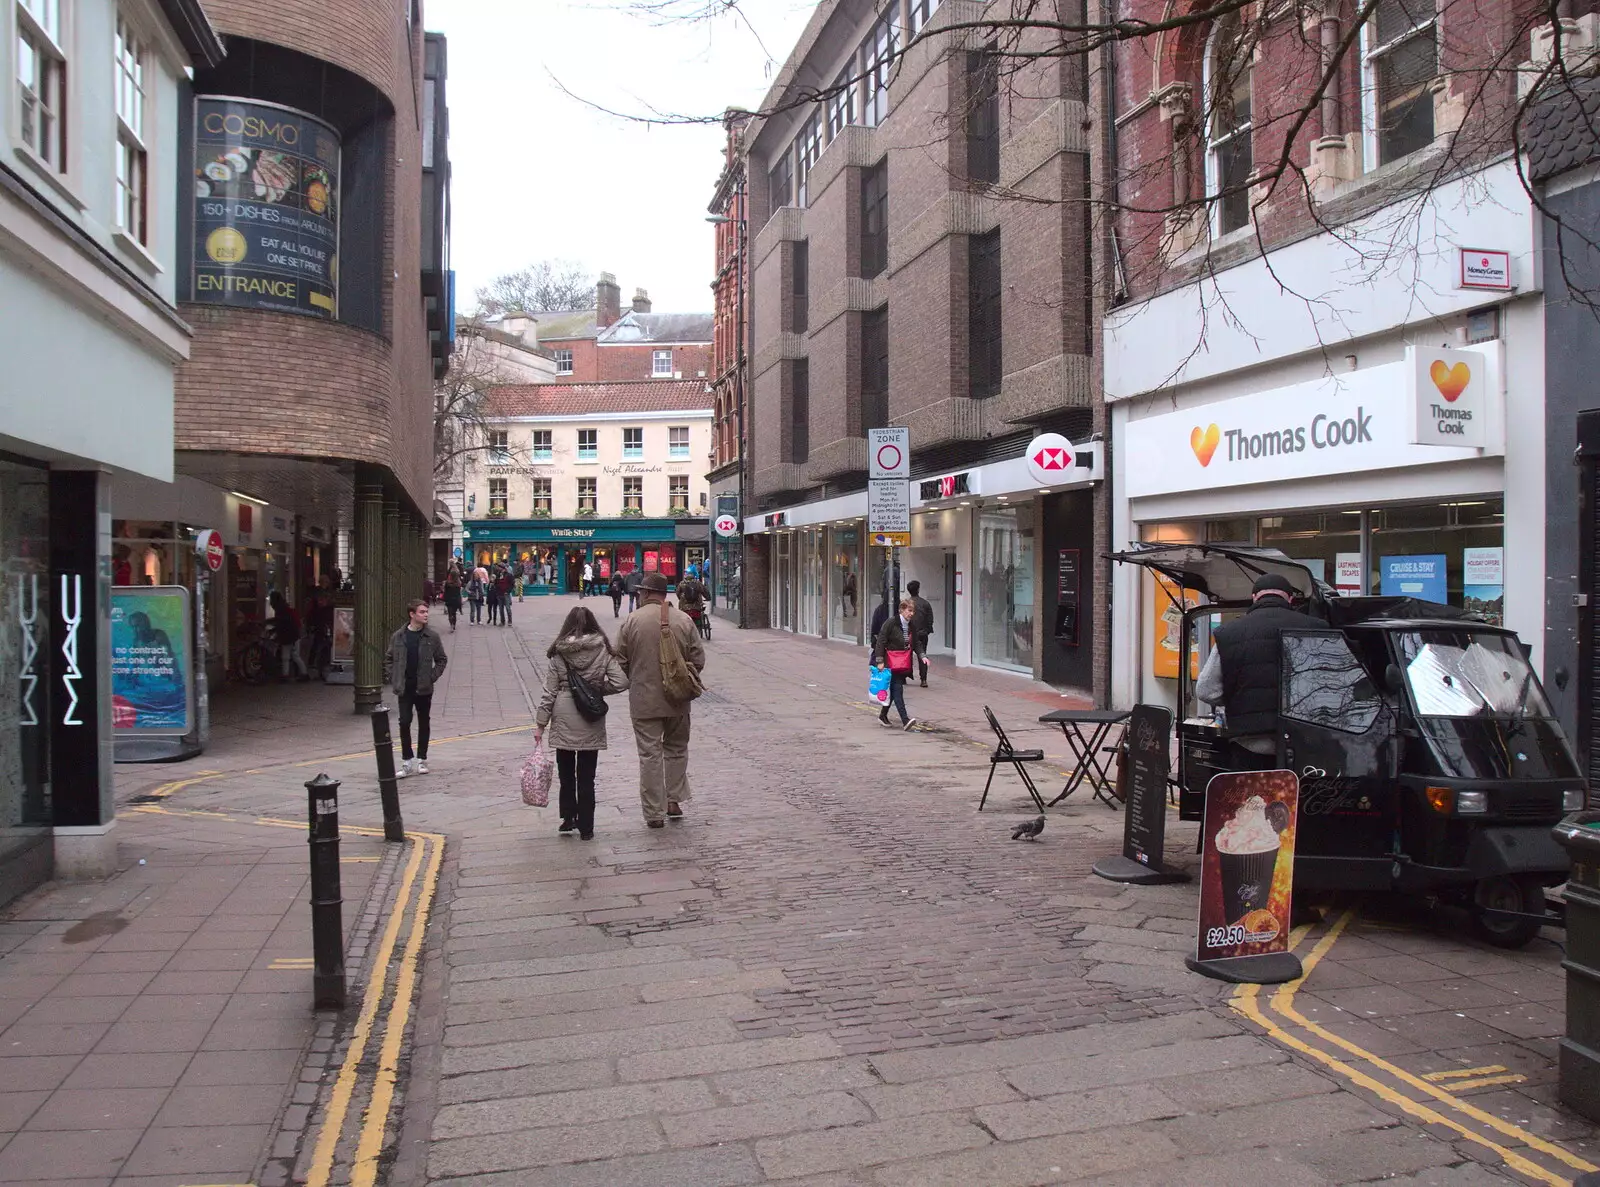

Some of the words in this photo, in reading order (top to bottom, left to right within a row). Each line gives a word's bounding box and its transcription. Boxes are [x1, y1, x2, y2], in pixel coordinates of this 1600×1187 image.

[204, 112, 298, 145] COSMO
[202, 203, 231, 217] 150+
[234, 204, 280, 223] DISHES
[261, 237, 279, 249] EAT
[281, 241, 298, 252] ALL
[267, 253, 288, 266] ONE
[1467, 266, 1504, 276] MoneyGram
[197, 273, 297, 300] ENTRANCE
[1430, 403, 1473, 421] Thomas
[1224, 425, 1306, 462] Thomas
[1310, 406, 1373, 450] Cook
[1437, 420, 1465, 436] Cook
[876, 435, 901, 443] ZONE
[489, 467, 535, 476] PAMPERS
[602, 465, 622, 477] Nigel
[624, 464, 663, 474] Alexandre
[1348, 561, 1361, 569] MINUT
[1390, 562, 1413, 573] CRUISE
[1418, 561, 1436, 573] STAY
[115, 646, 127, 655] no
[128, 646, 168, 656] contract,
[128, 656, 146, 665] one
[146, 655, 157, 665] of
[158, 656, 173, 665] our
[132, 664, 174, 677] strengths
[1207, 925, 1246, 947] £2.50
